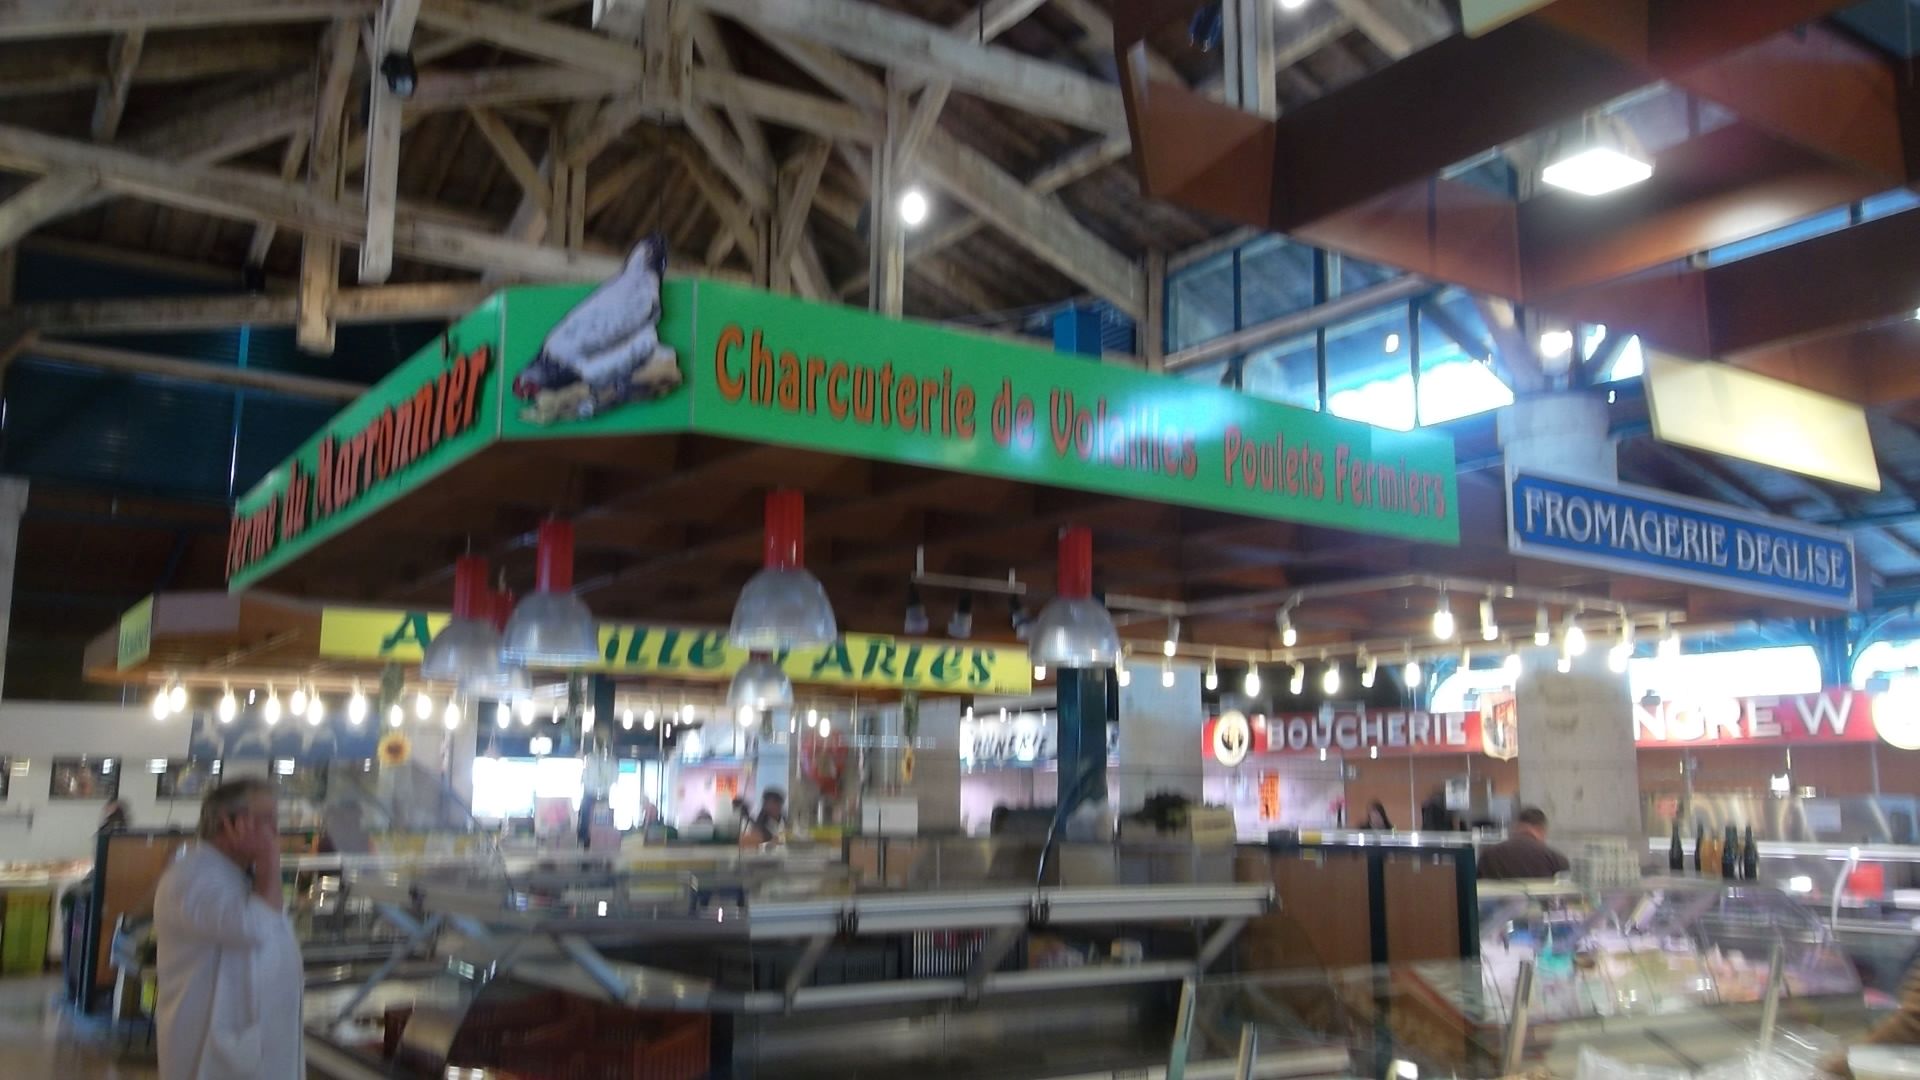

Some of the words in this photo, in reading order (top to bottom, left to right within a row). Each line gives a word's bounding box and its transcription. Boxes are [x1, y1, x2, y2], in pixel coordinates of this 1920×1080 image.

[282, 459, 308, 542] du
[313, 334, 488, 522] Marronnier
[715, 324, 977, 441] Charcuterie
[991, 375, 1036, 450] de
[1049, 386, 1198, 479] Volailles
[1224, 425, 1324, 500] Poulets
[1334, 444, 1446, 520] Fermiers
[1524, 486, 1727, 567] FROMAGERIE
[1737, 527, 1846, 588] DEGLISE
[1267, 712, 1467, 750] BOUCHERIE
